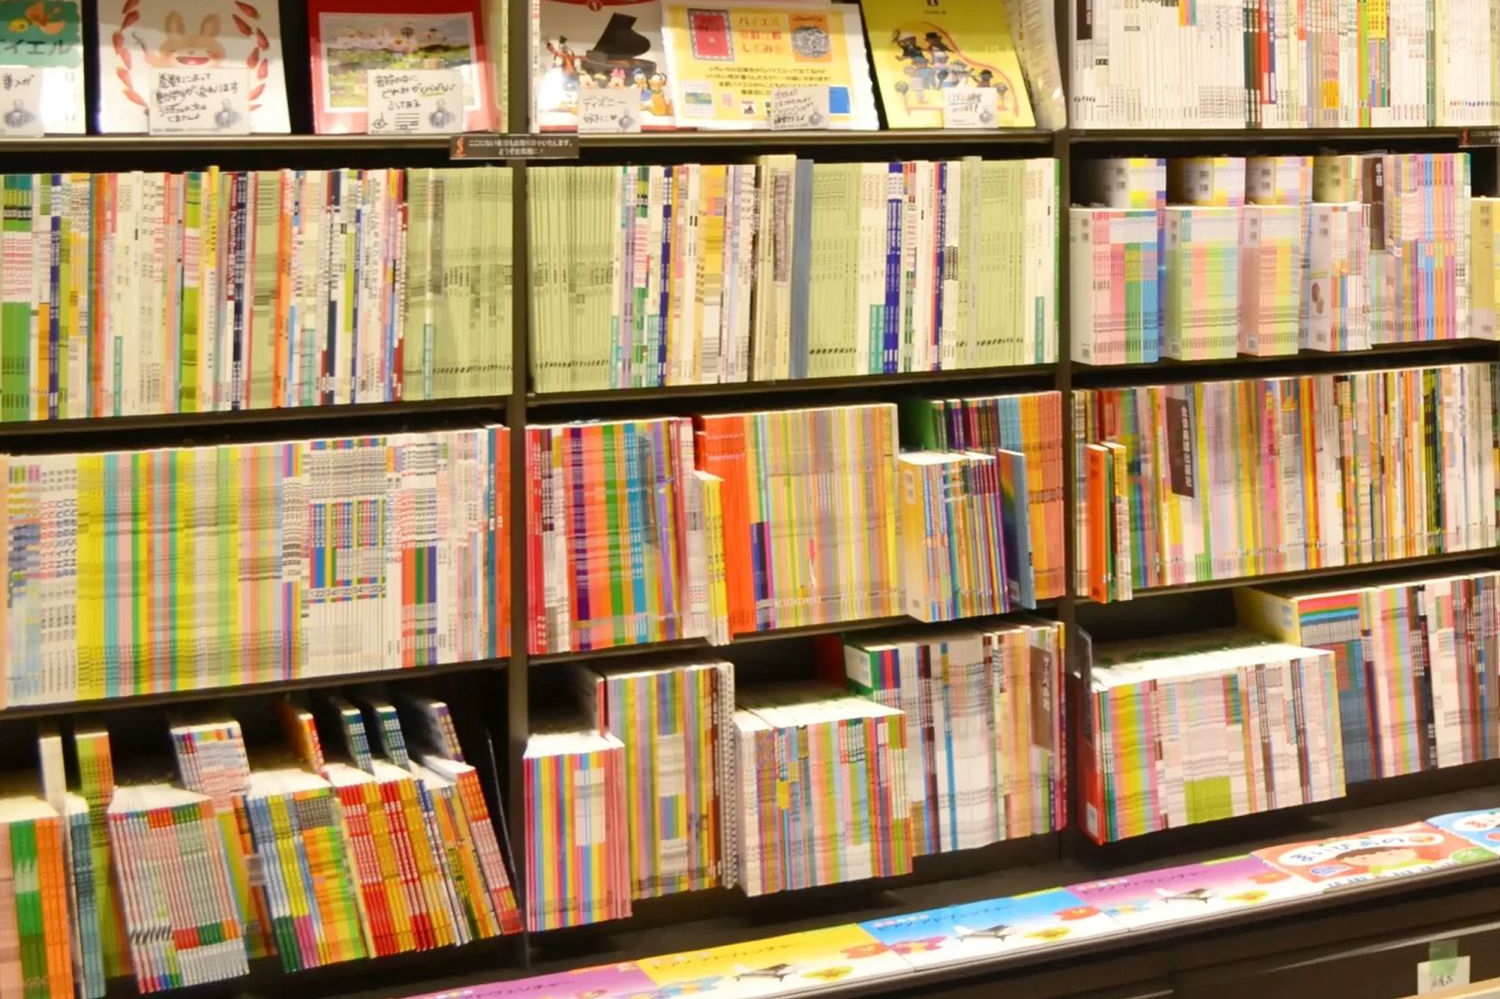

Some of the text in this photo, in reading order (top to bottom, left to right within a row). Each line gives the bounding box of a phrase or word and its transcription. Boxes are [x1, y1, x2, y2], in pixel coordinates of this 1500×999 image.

[581, 93, 627, 109] ディズニー
